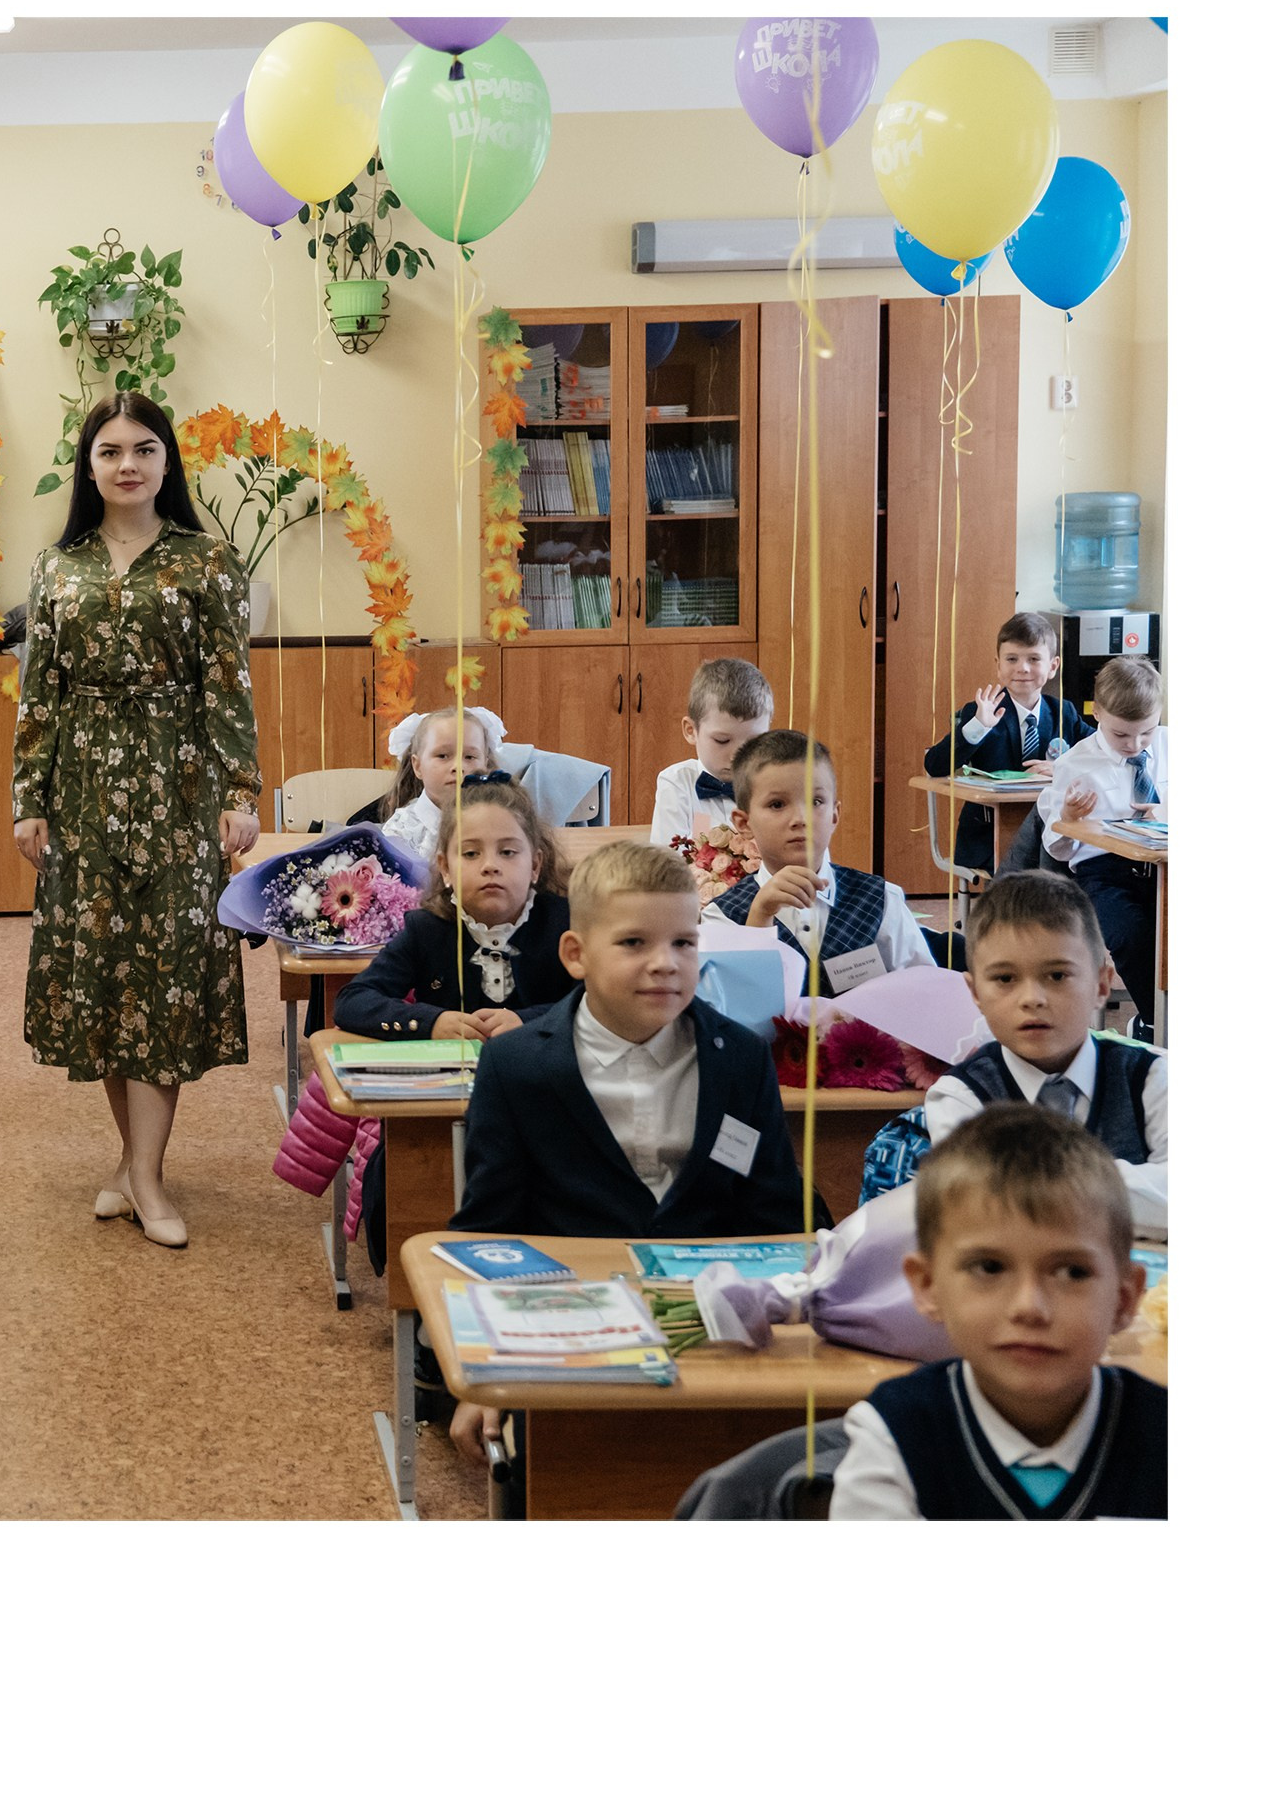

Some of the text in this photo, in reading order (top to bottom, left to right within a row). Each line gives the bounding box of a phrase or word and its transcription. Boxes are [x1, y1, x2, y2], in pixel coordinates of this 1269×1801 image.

[453, 77, 544, 104] ПРИВЕ
[196, 165, 205, 178] 9
[215, 194, 223, 206] 7
